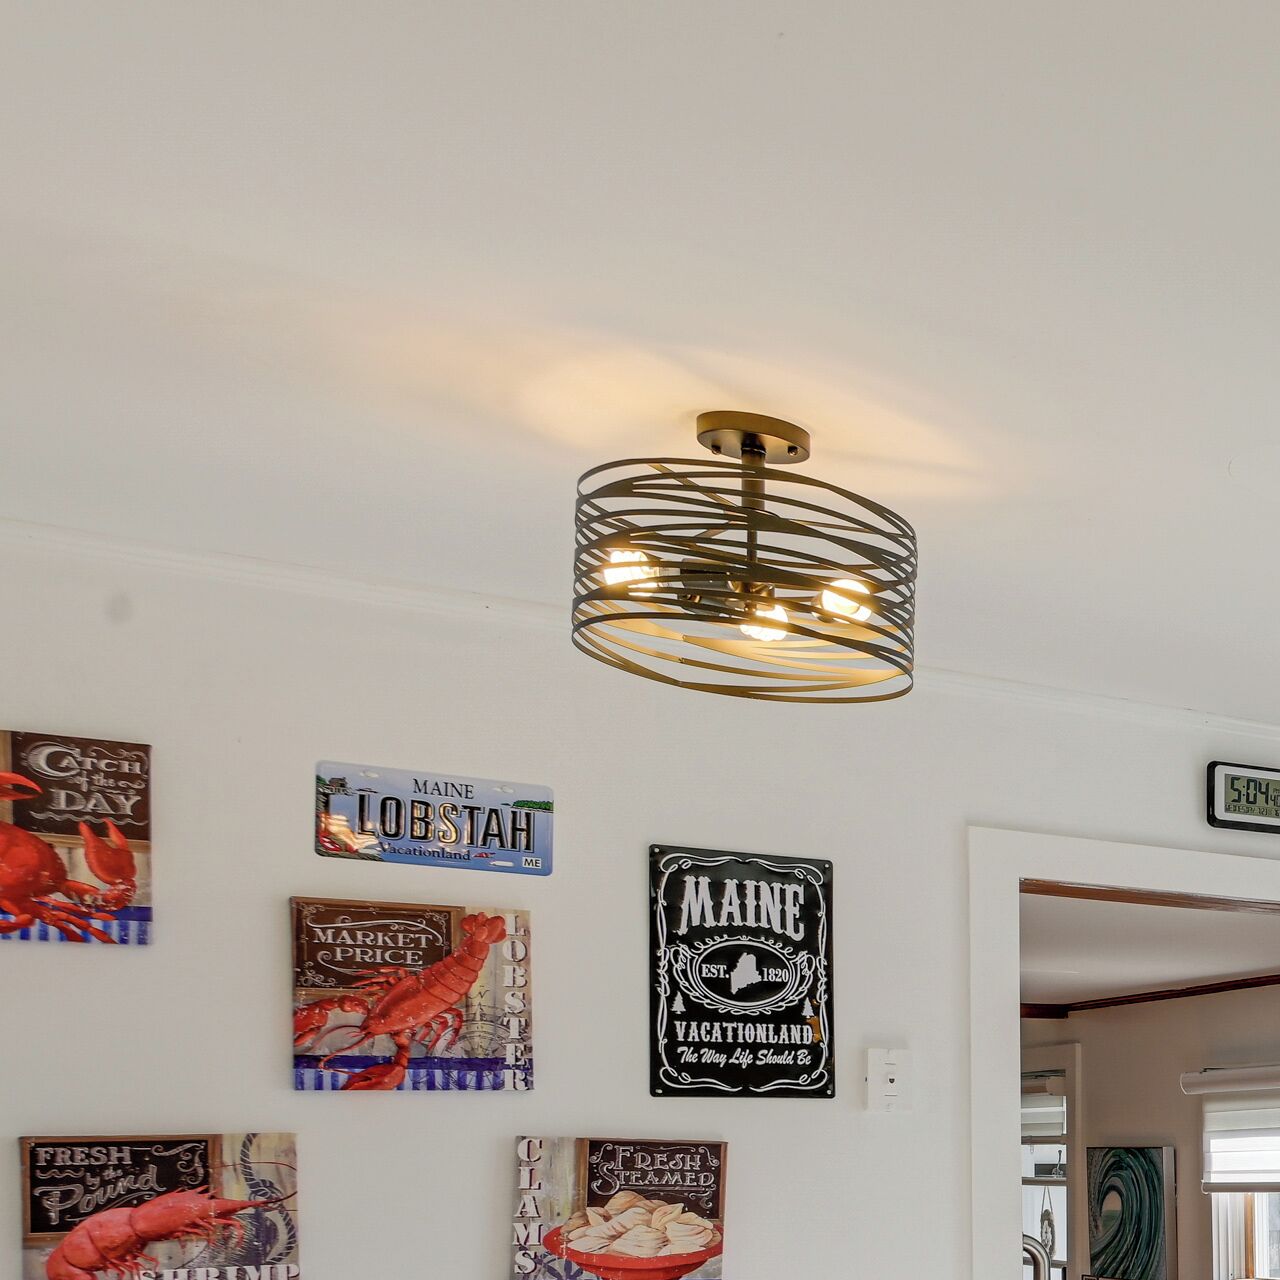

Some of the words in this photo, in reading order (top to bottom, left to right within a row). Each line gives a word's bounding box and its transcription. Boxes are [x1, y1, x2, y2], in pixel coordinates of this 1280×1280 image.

[412, 778, 475, 799] MAINE
[1230, 776, 1270, 805] 5:04
[48, 788, 142, 815] DAY
[357, 792, 536, 853] LOBSTAH
[378, 842, 471, 861] Vacationland
[523, 857, 541, 868] ME
[672, 875, 805, 942] MAINE
[312, 928, 434, 949] MARKET
[333, 946, 424, 965] PRICE
[701, 963, 730, 979] EST.
[762, 967, 789, 982] 1820
[502, 913, 530, 1090] LOBSTER
[673, 1020, 813, 1045] VACATIONLAND
[677, 1046, 699, 1063] The
[700, 1048, 727, 1068] Way
[729, 1049, 754, 1069] Life
[756, 1049, 794, 1066] Should
[796, 1050, 812, 1065] Be
[35, 1146, 132, 1166] FRESH
[613, 1145, 702, 1171] FRESH
[85, 1171, 101, 1190] by
[102, 1168, 124, 1180] the
[591, 1161, 715, 1195] STEAMED
[33, 1164, 167, 1225] Pound
[512, 1138, 544, 1275] CLAMS
